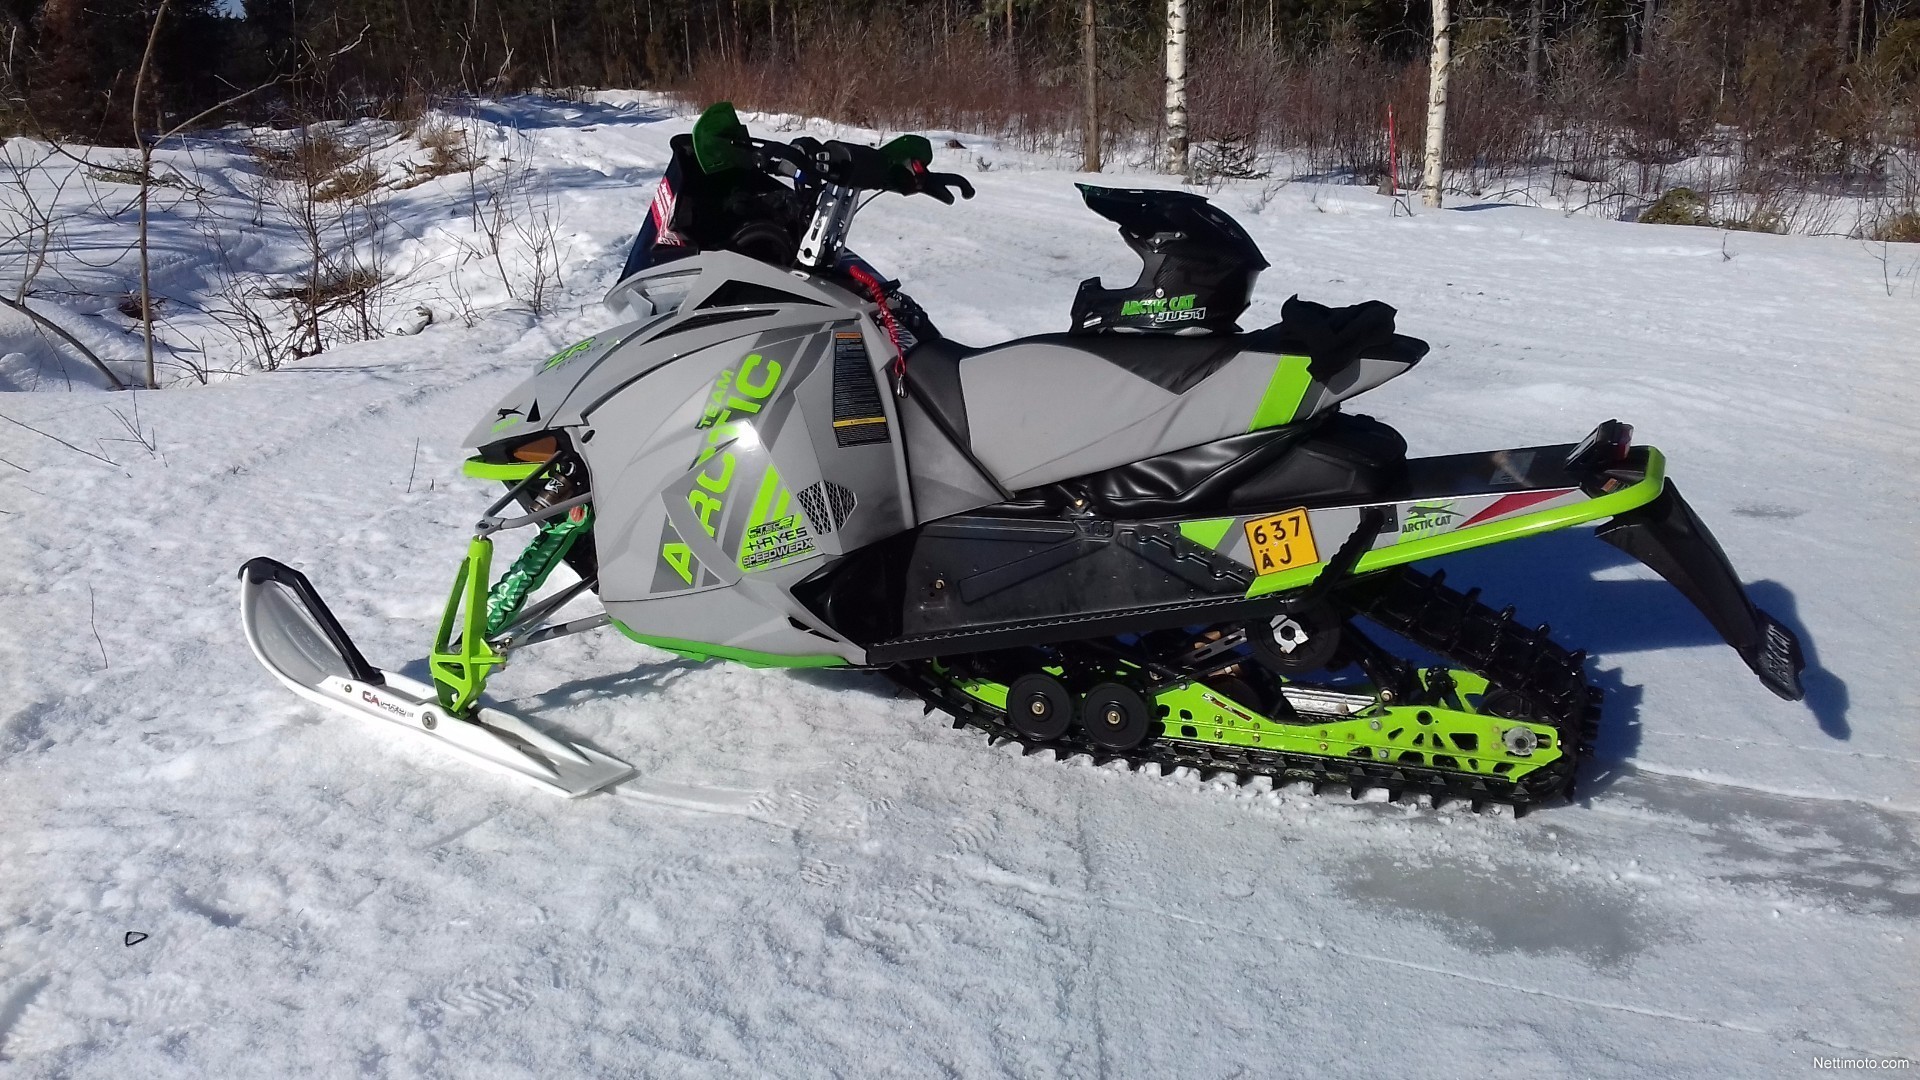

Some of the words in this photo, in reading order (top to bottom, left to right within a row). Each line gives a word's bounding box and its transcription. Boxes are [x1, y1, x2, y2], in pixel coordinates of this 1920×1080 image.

[1121, 298, 1168, 316] ARCTIC
[1169, 294, 1196, 311] CAT
[698, 369, 735, 430] TEAM
[663, 354, 782, 585] ARCTIC
[745, 526, 808, 551] HAYES
[1253, 515, 1301, 545] 637
[1401, 520, 1434, 534] ARCTIC
[1435, 515, 1451, 527] CAT
[742, 537, 813, 565] SPEEDWERX
